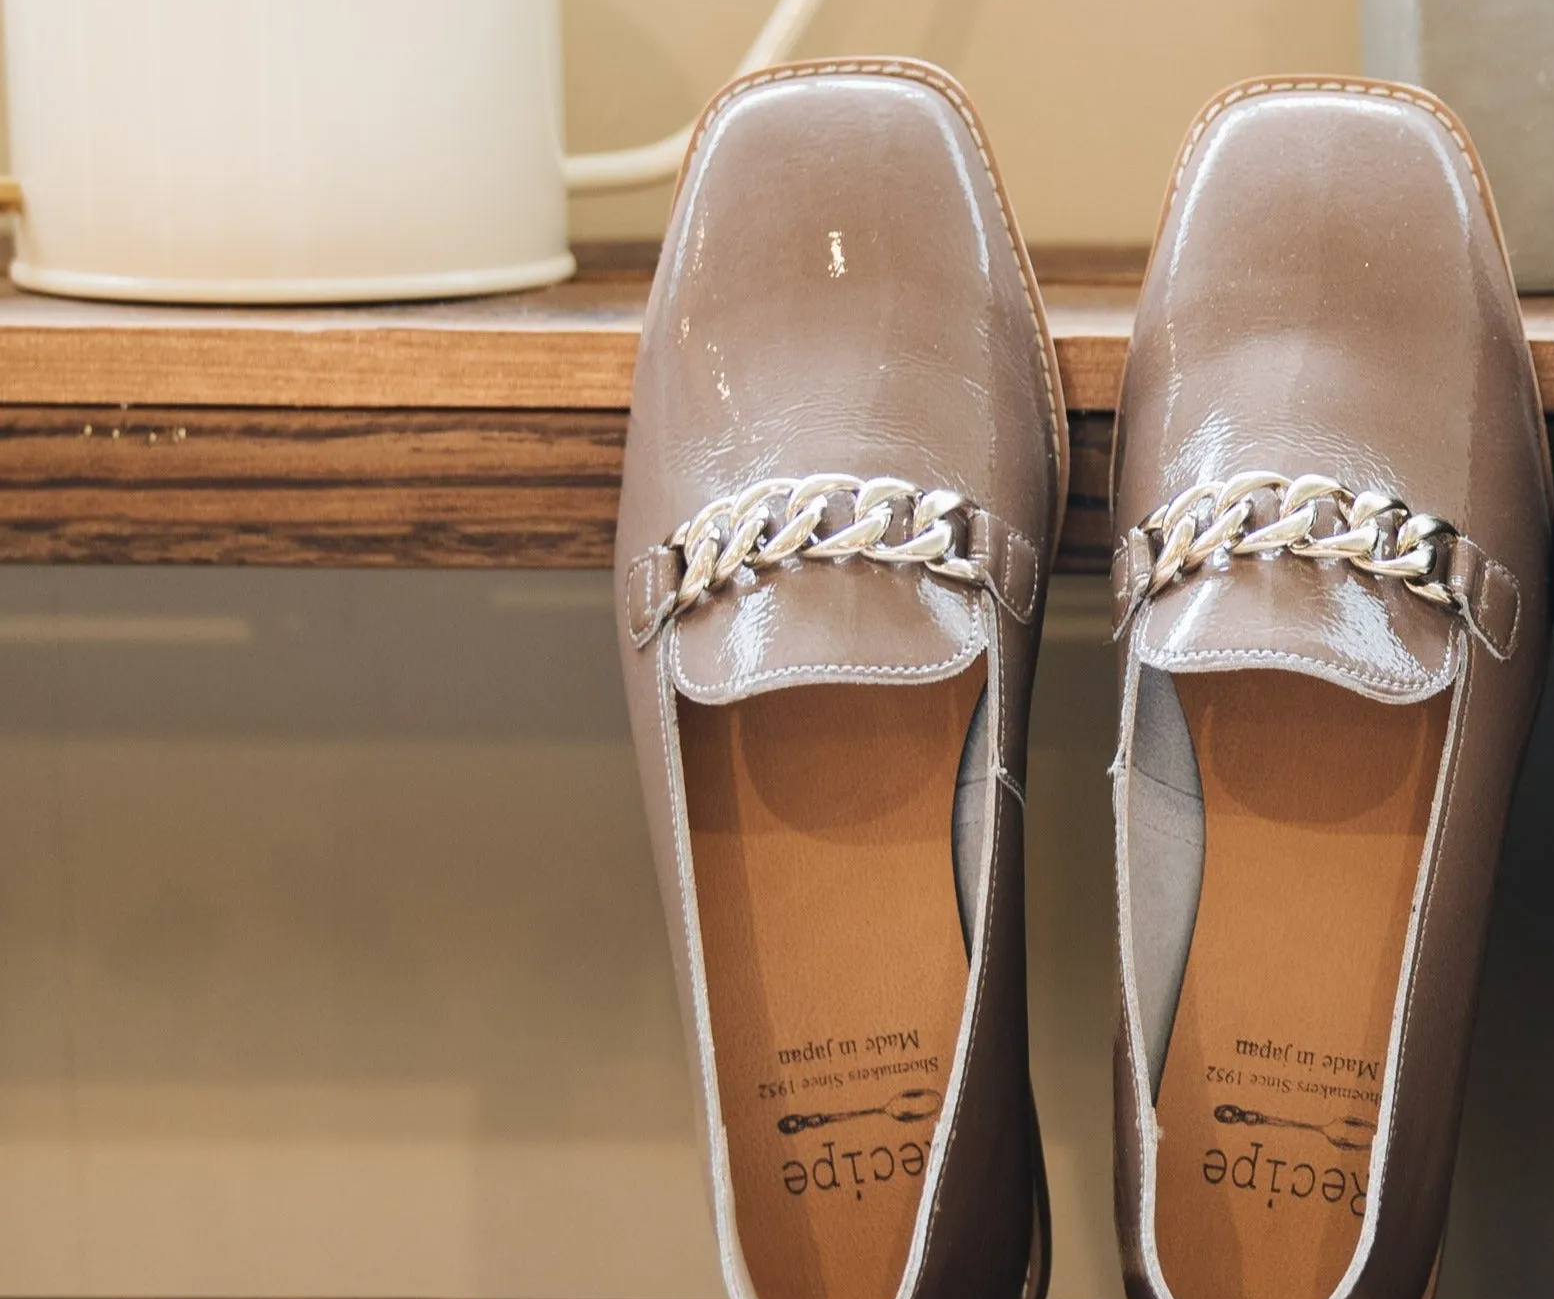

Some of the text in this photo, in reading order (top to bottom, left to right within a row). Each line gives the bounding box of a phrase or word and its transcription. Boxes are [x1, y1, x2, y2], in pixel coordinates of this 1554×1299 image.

[839, 1040, 857, 1058] in
[865, 1030, 918, 1055] Made
[1296, 1050, 1314, 1071] in
[1321, 1055, 1380, 1080] Made
[758, 1056, 939, 1099] Shoemakers Since 1952
[1205, 1066, 1380, 1106] hoemakers Since 1952
[782, 1141, 932, 1201] ecipe
[1202, 1142, 1369, 1217] Recipe
